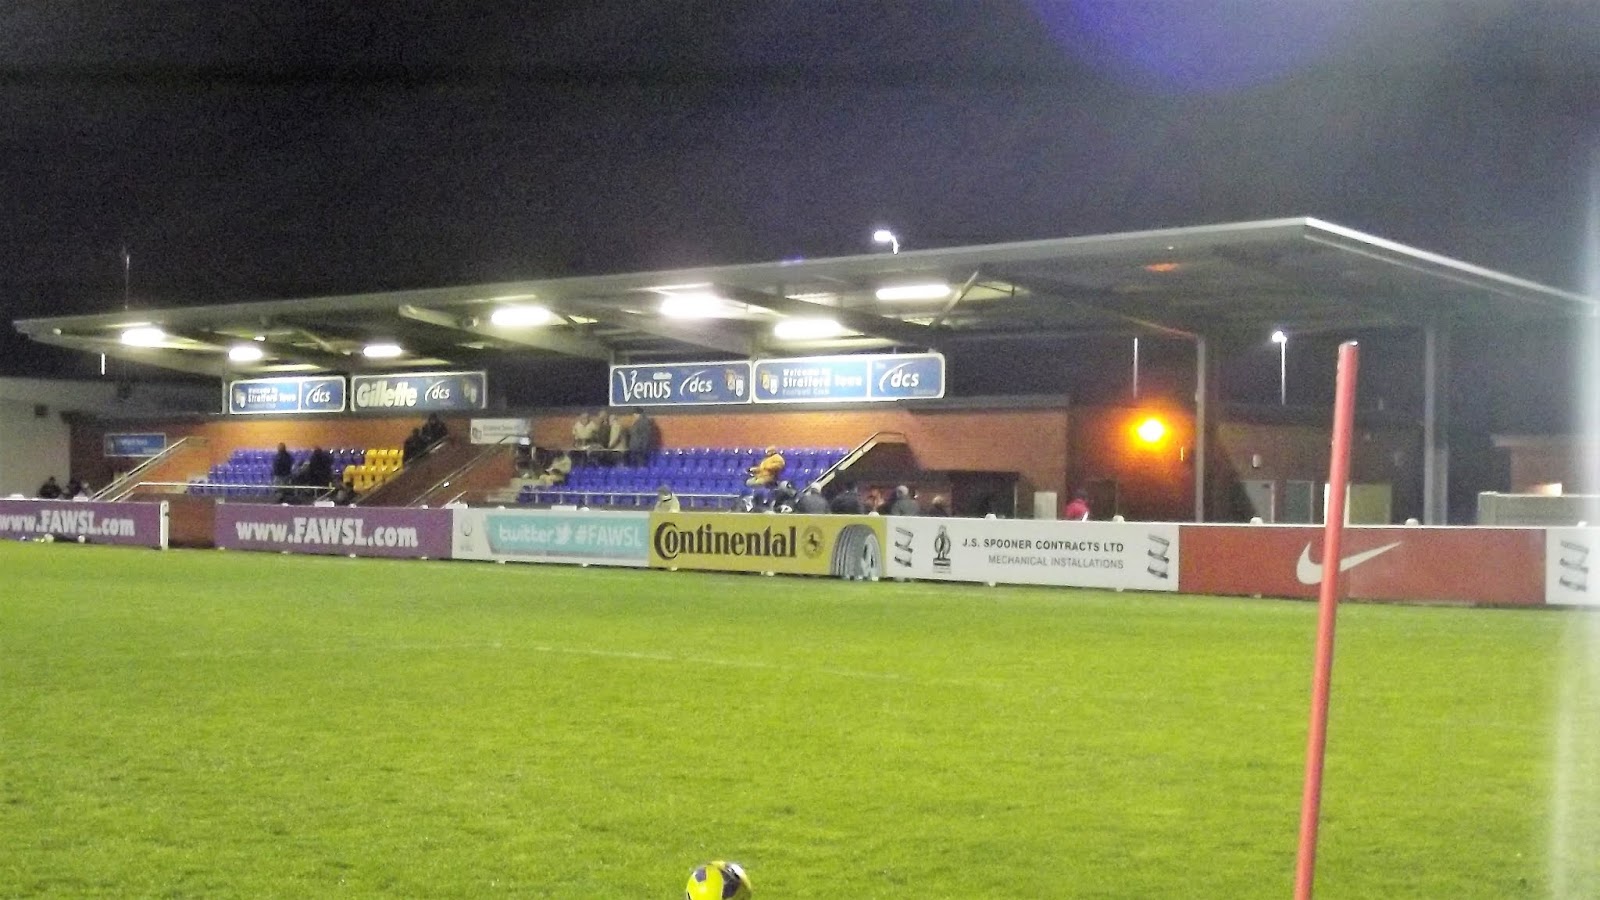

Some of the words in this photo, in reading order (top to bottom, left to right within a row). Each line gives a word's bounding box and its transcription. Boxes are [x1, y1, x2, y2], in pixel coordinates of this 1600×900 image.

[617, 370, 671, 402] Venus
[689, 377, 713, 393] dcs
[890, 367, 919, 388] dcs
[312, 387, 331, 403] dcs
[356, 380, 418, 407] Gillette
[431, 385, 450, 400] dcs
[0, 509, 135, 537] www.FAWSL.com
[235, 517, 419, 548] www.FAWSL.com
[500, 523, 556, 543] twitter
[575, 524, 643, 547] #FAWSL
[654, 521, 797, 560] Continental
[962, 538, 980, 547] J.S.
[983, 538, 1032, 549] SPOONER
[1035, 540, 1100, 552] CONTRACTS
[1103, 542, 1124, 552] LTD
[988, 554, 1048, 567] MECHANICAL
[1050, 557, 1124, 570] INSTALLATIONS
